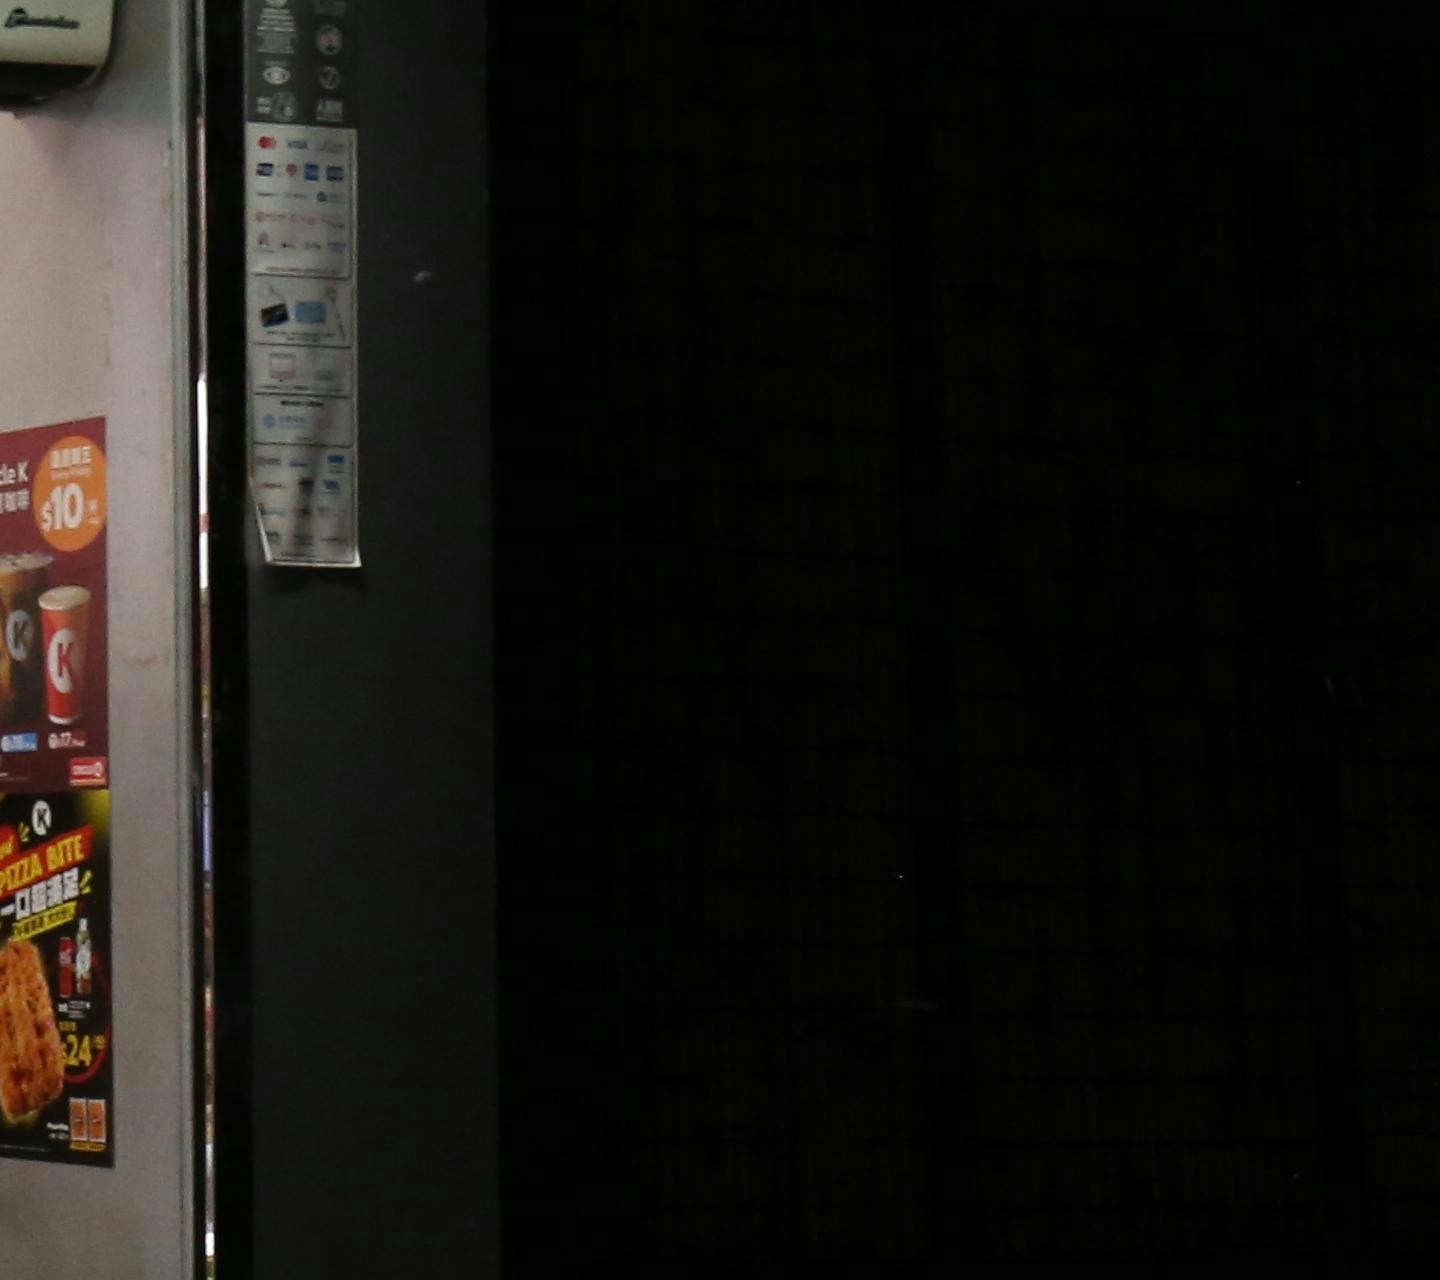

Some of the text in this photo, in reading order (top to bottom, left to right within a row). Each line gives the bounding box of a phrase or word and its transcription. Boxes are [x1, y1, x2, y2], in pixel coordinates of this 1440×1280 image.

[18, 460, 29, 483] K
[42, 482, 84, 532] $10
[45, 833, 85, 872] BITE
[61, 1034, 92, 1068] $24
